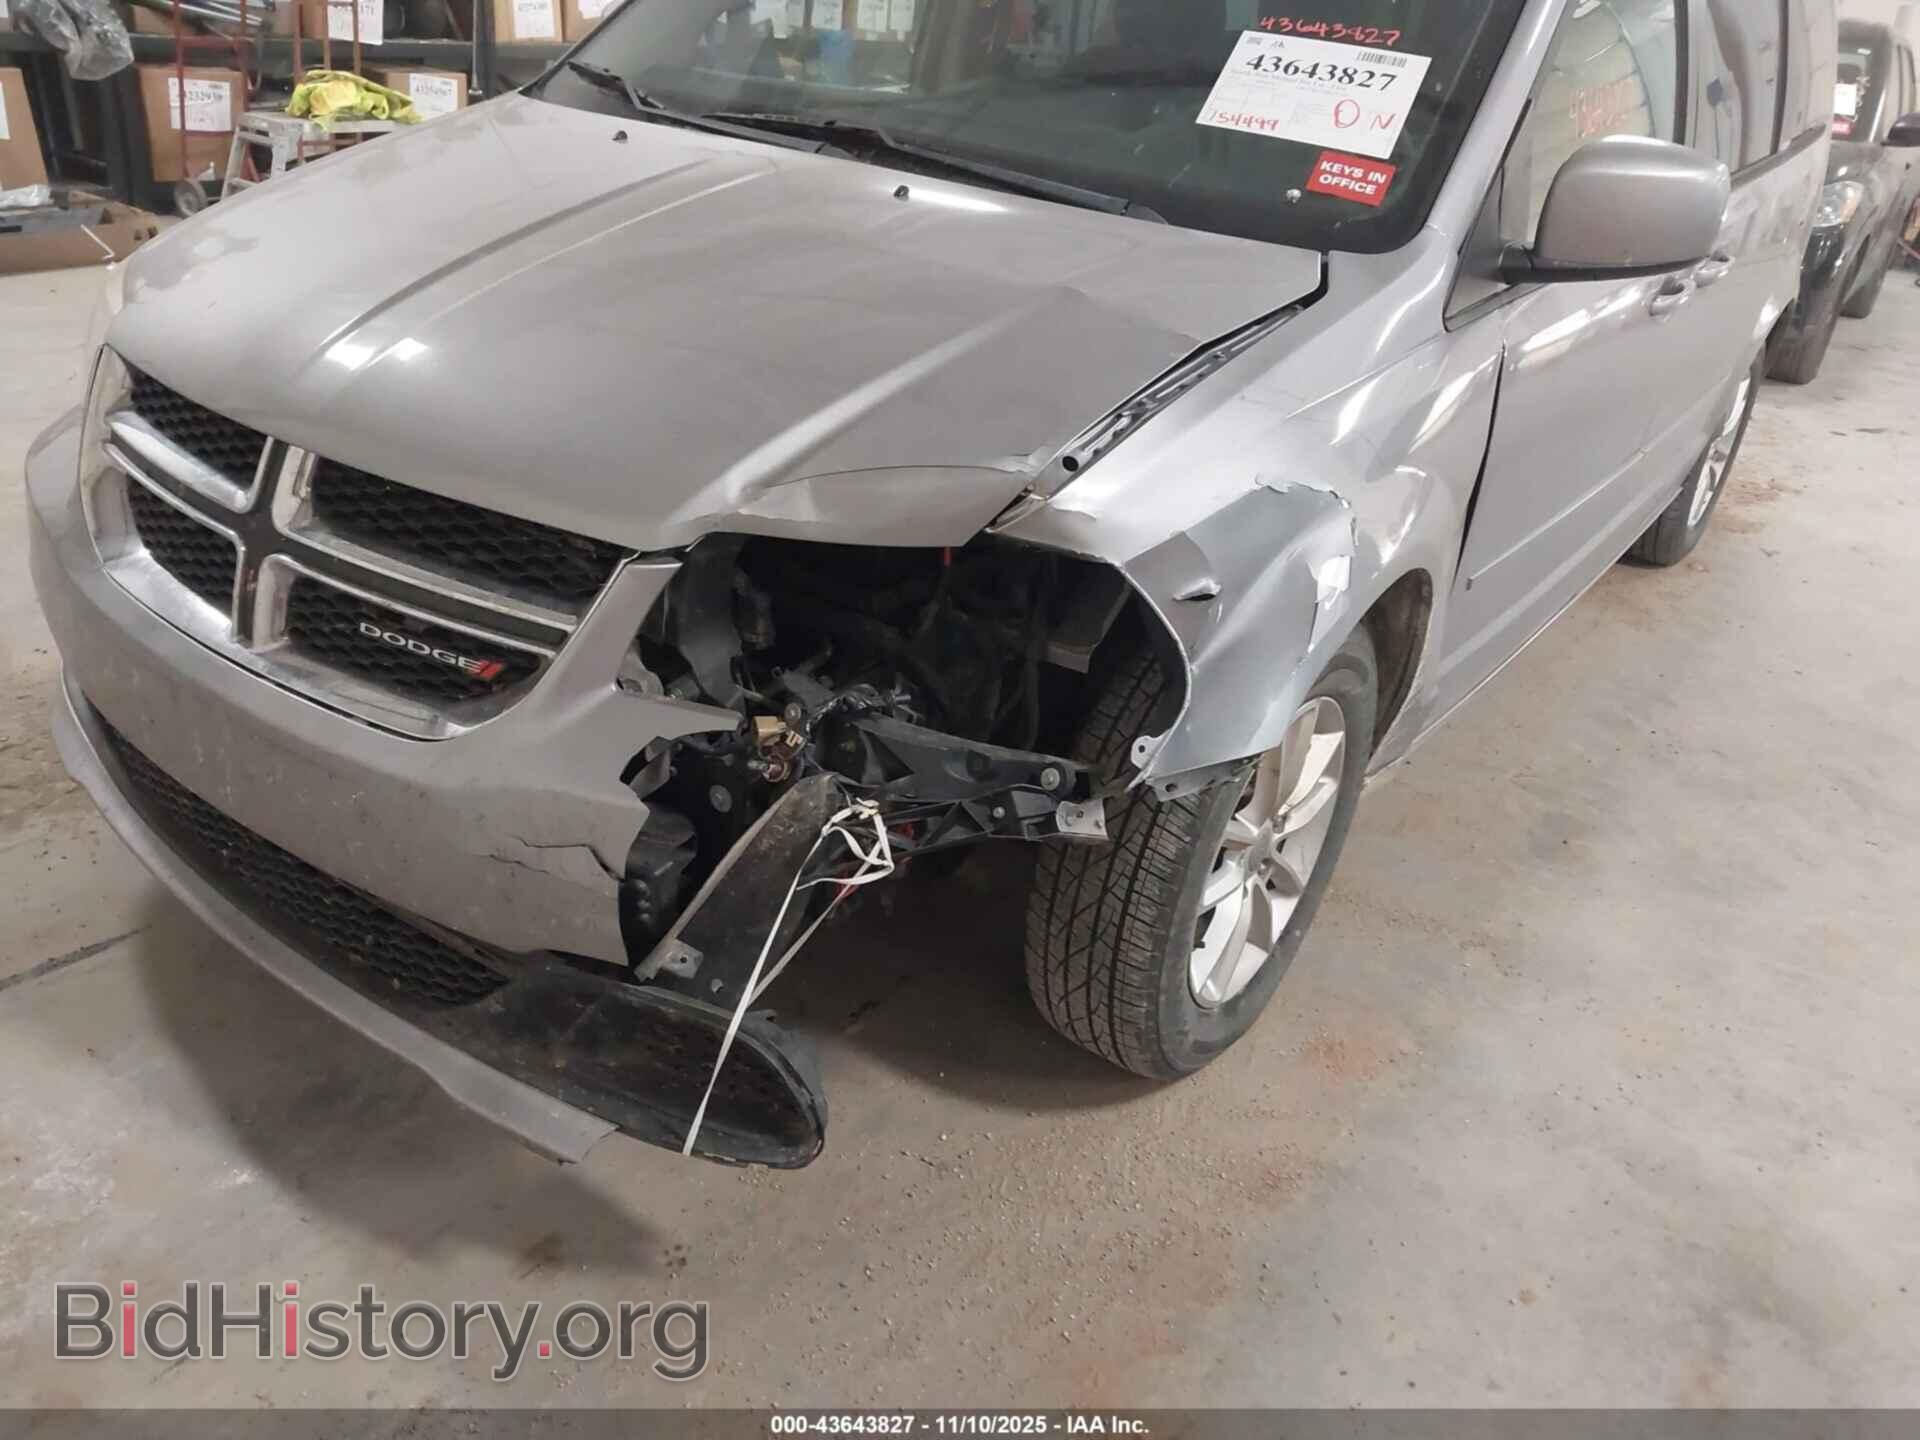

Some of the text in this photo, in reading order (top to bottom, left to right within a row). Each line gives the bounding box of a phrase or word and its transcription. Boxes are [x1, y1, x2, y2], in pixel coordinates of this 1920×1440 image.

[1245, 53, 1397, 92] 43643827
[1319, 174, 1377, 195] OFFICE
[1320, 160, 1387, 184] KEYS IN
[359, 621, 482, 673] DODGE
